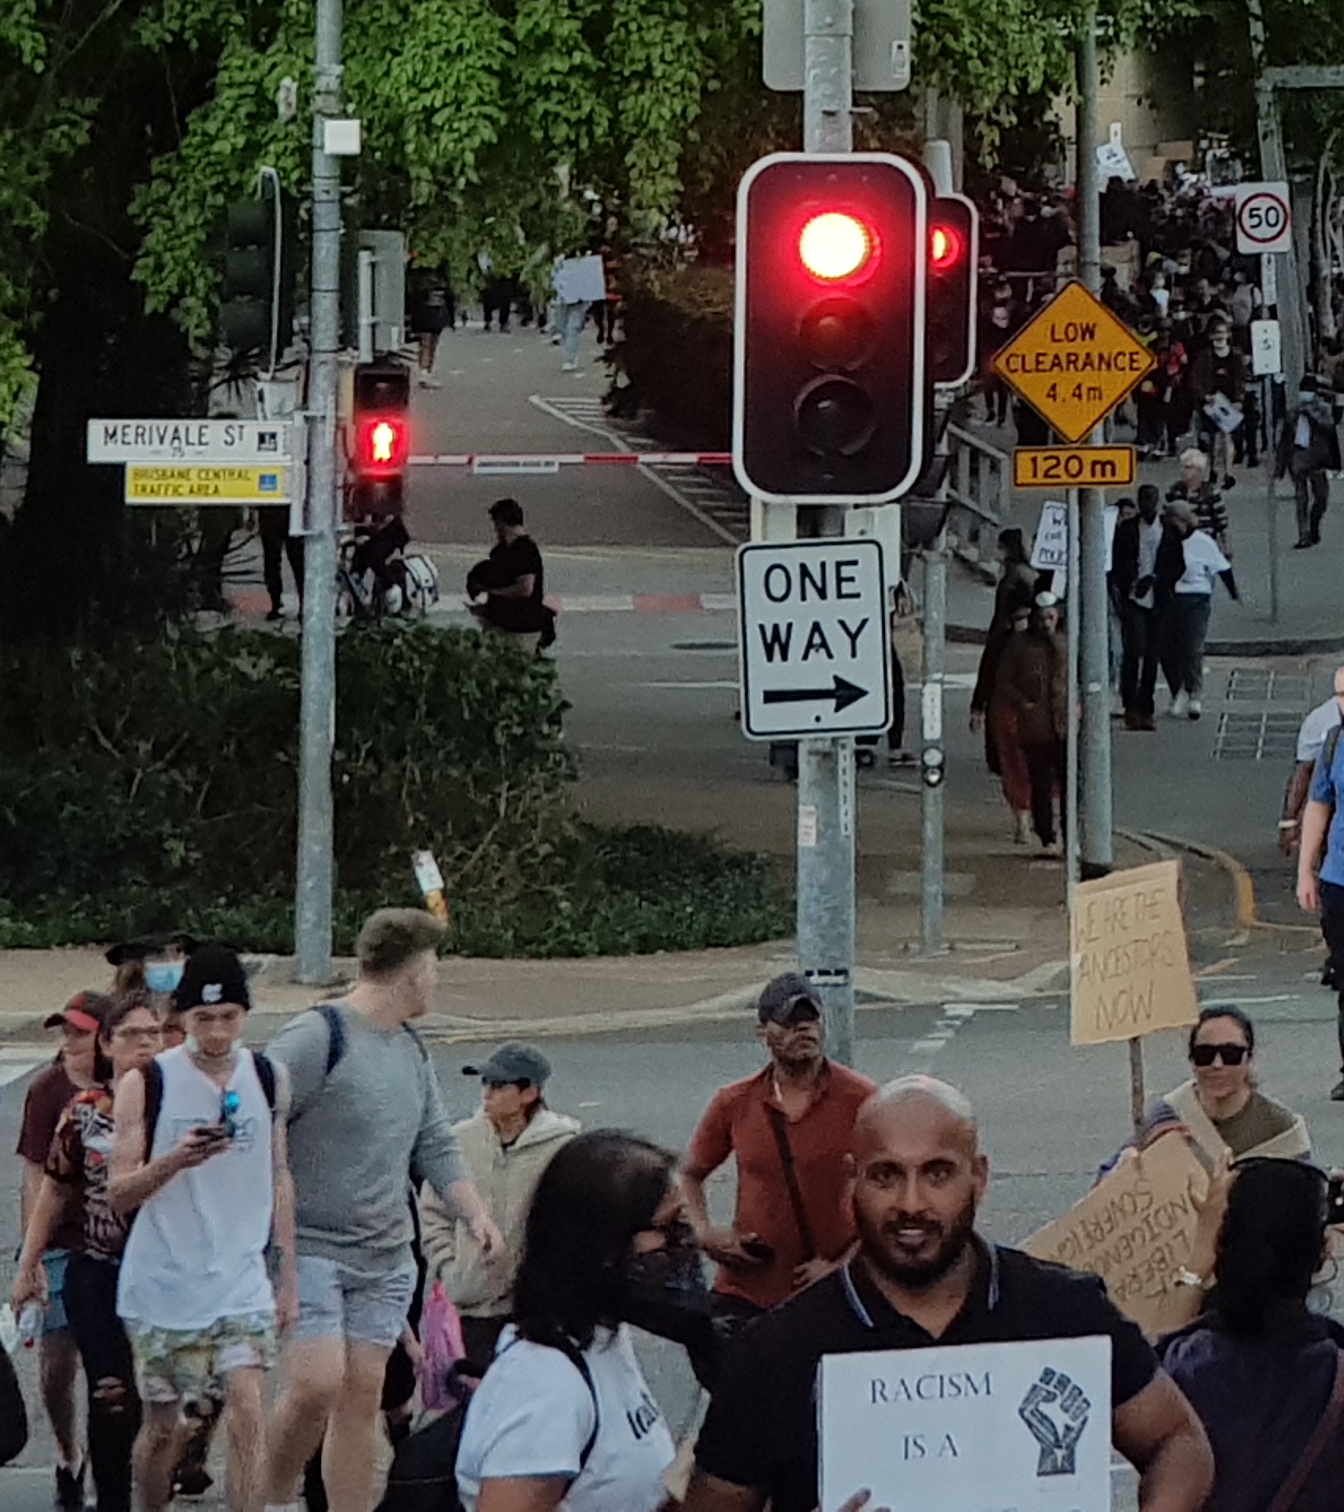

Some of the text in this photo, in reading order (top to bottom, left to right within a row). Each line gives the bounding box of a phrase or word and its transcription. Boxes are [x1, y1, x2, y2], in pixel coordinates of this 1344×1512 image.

[1248, 206, 1280, 228] 50
[1051, 323, 1097, 343] LOW
[1006, 351, 1141, 374] CLEARANCE
[104, 424, 209, 446] MERIVALE
[132, 468, 251, 481] BRISBANE CENTRAL
[133, 484, 219, 496] TRAFFIC AREA
[763, 559, 862, 603] ONE
[758, 617, 870, 663] WAY
[1096, 981, 1155, 1031] NOW
[870, 1371, 994, 1405] RACISM
[903, 1433, 959, 1461] IS A
